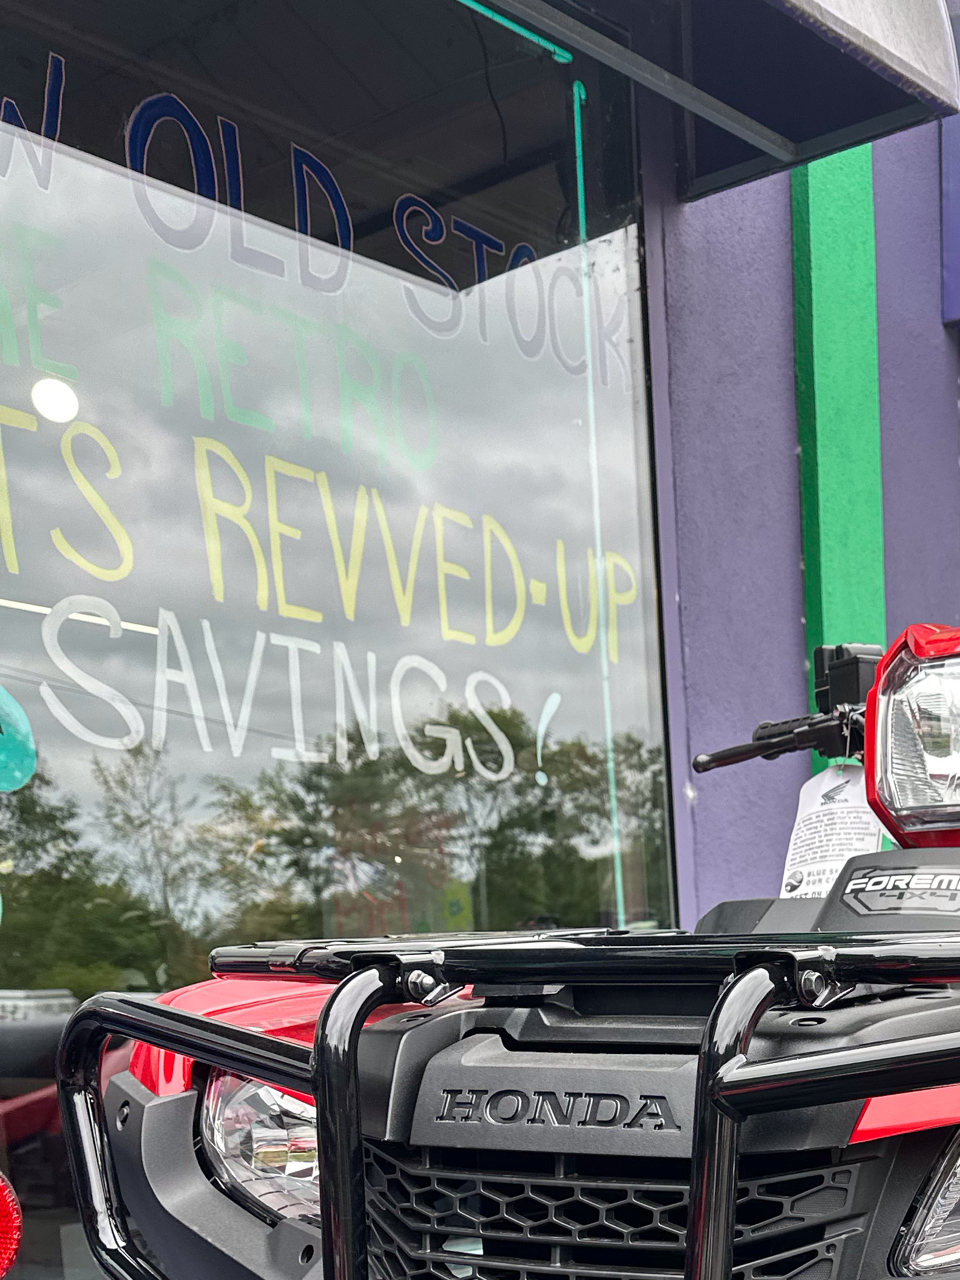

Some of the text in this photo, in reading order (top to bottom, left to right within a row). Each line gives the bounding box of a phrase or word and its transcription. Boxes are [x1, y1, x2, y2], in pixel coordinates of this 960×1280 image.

[126, 93, 354, 294] OLD
[394, 193, 631, 394] STOCK
[146, 256, 439, 472] RETRO
[435, 1089, 682, 1132] HONDA
